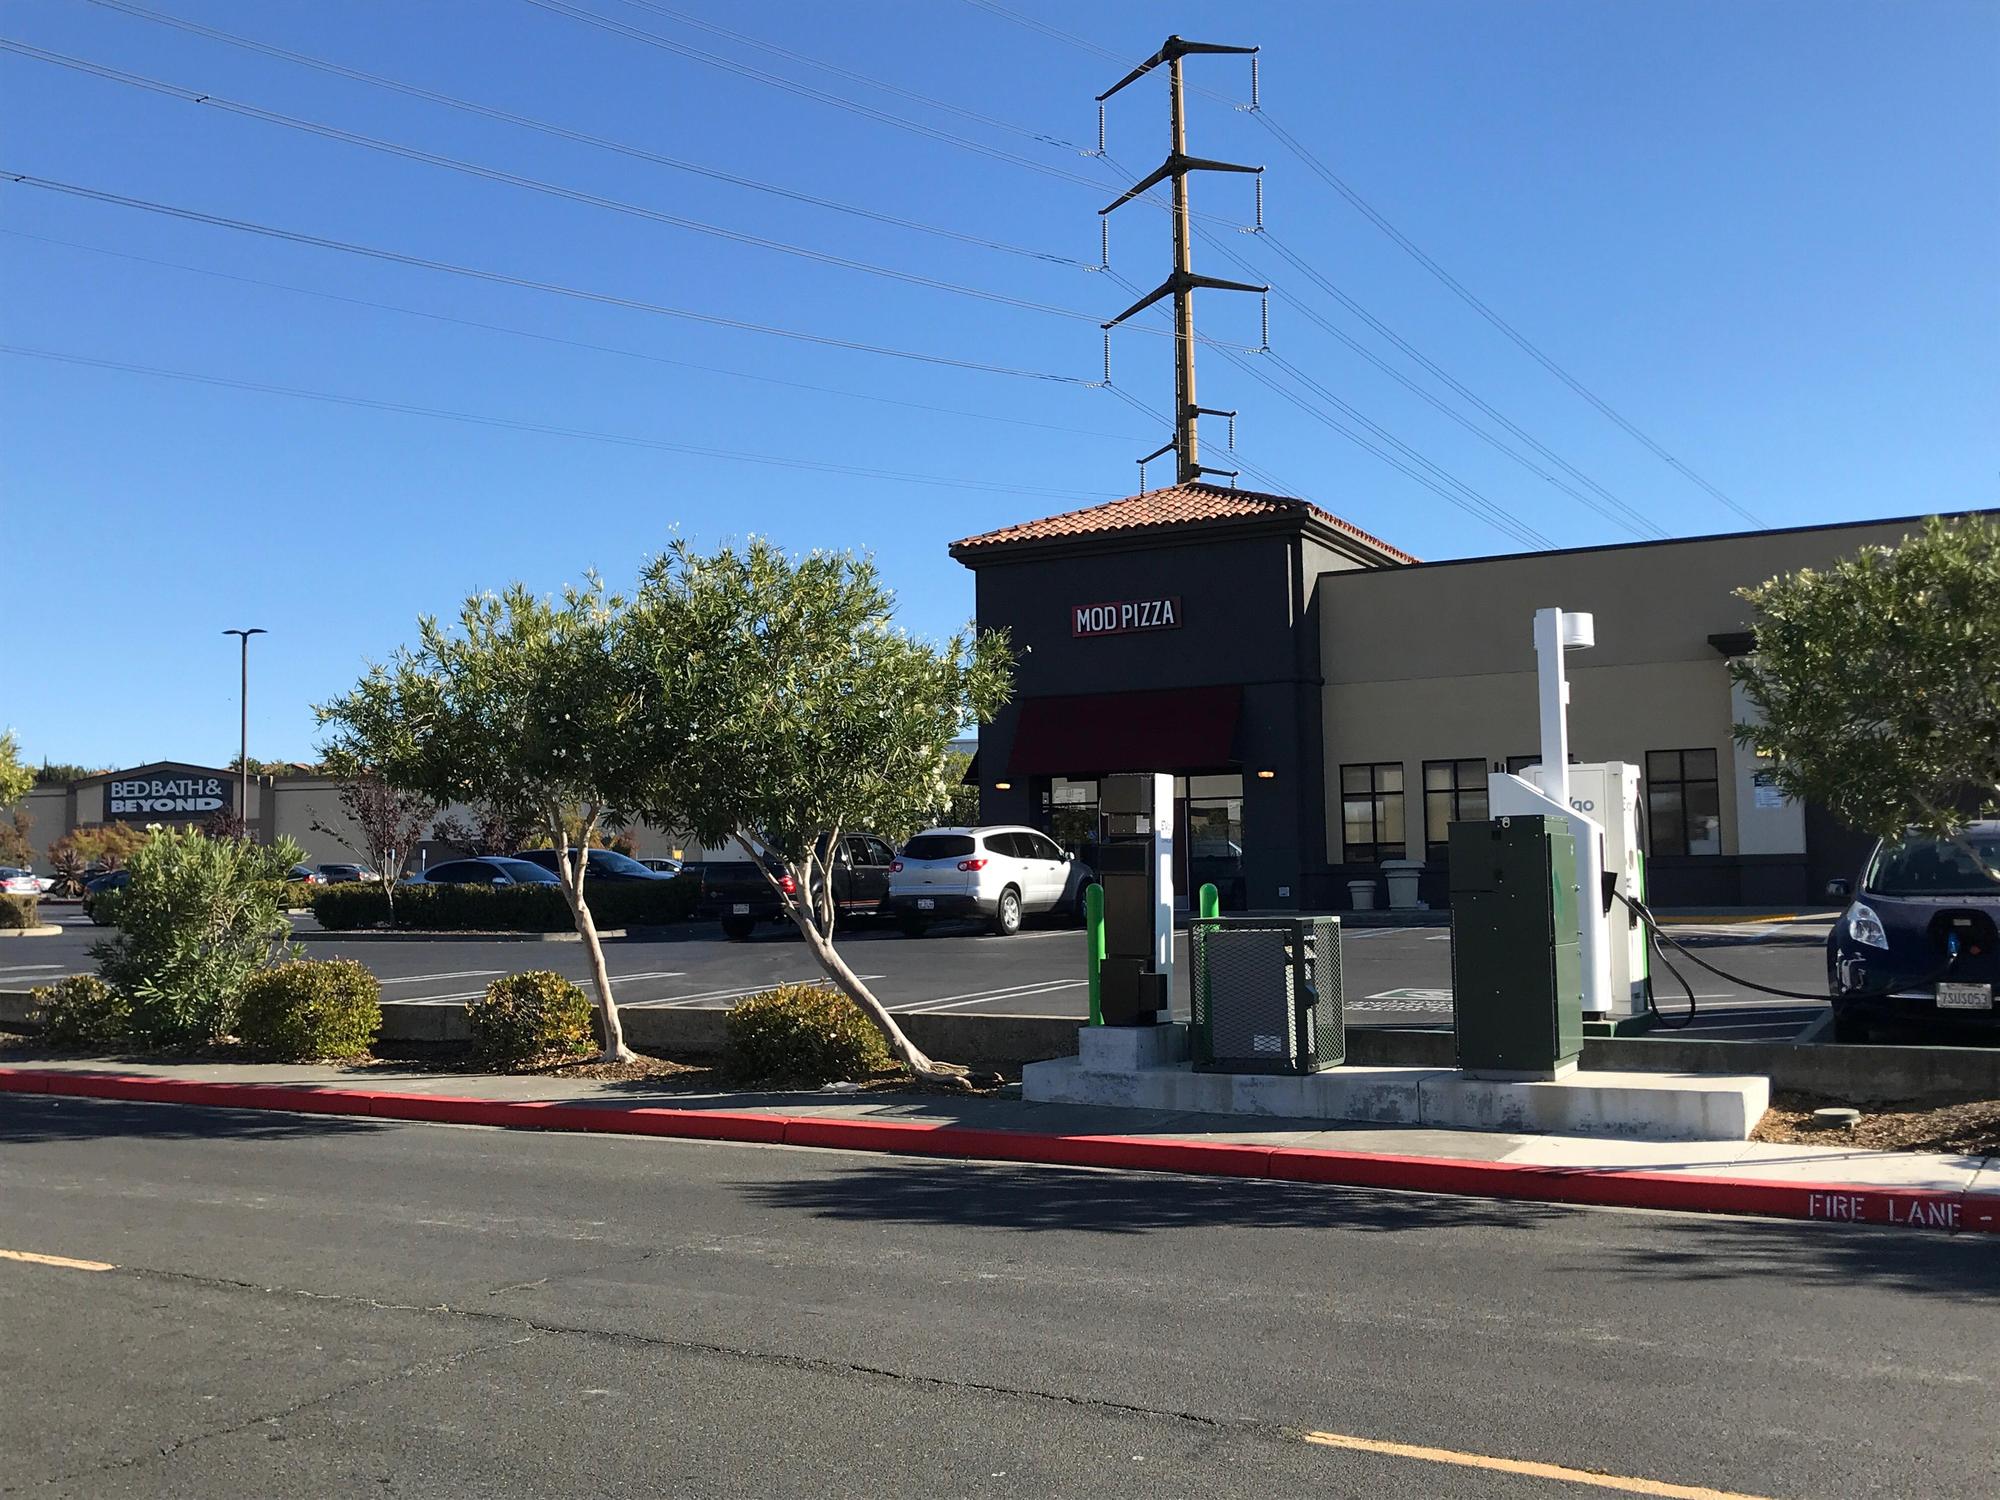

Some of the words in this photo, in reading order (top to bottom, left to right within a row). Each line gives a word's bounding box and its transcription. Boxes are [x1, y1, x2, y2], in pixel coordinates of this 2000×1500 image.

[1077, 606, 1117, 633] MOD
[1121, 600, 1175, 629] PIZZA
[111, 781, 150, 798] BED
[151, 779, 203, 797] BATH
[111, 797, 223, 813] BEYOND
[1809, 1194, 1865, 1220] FIRE
[1888, 1199, 1962, 1228] LANE
